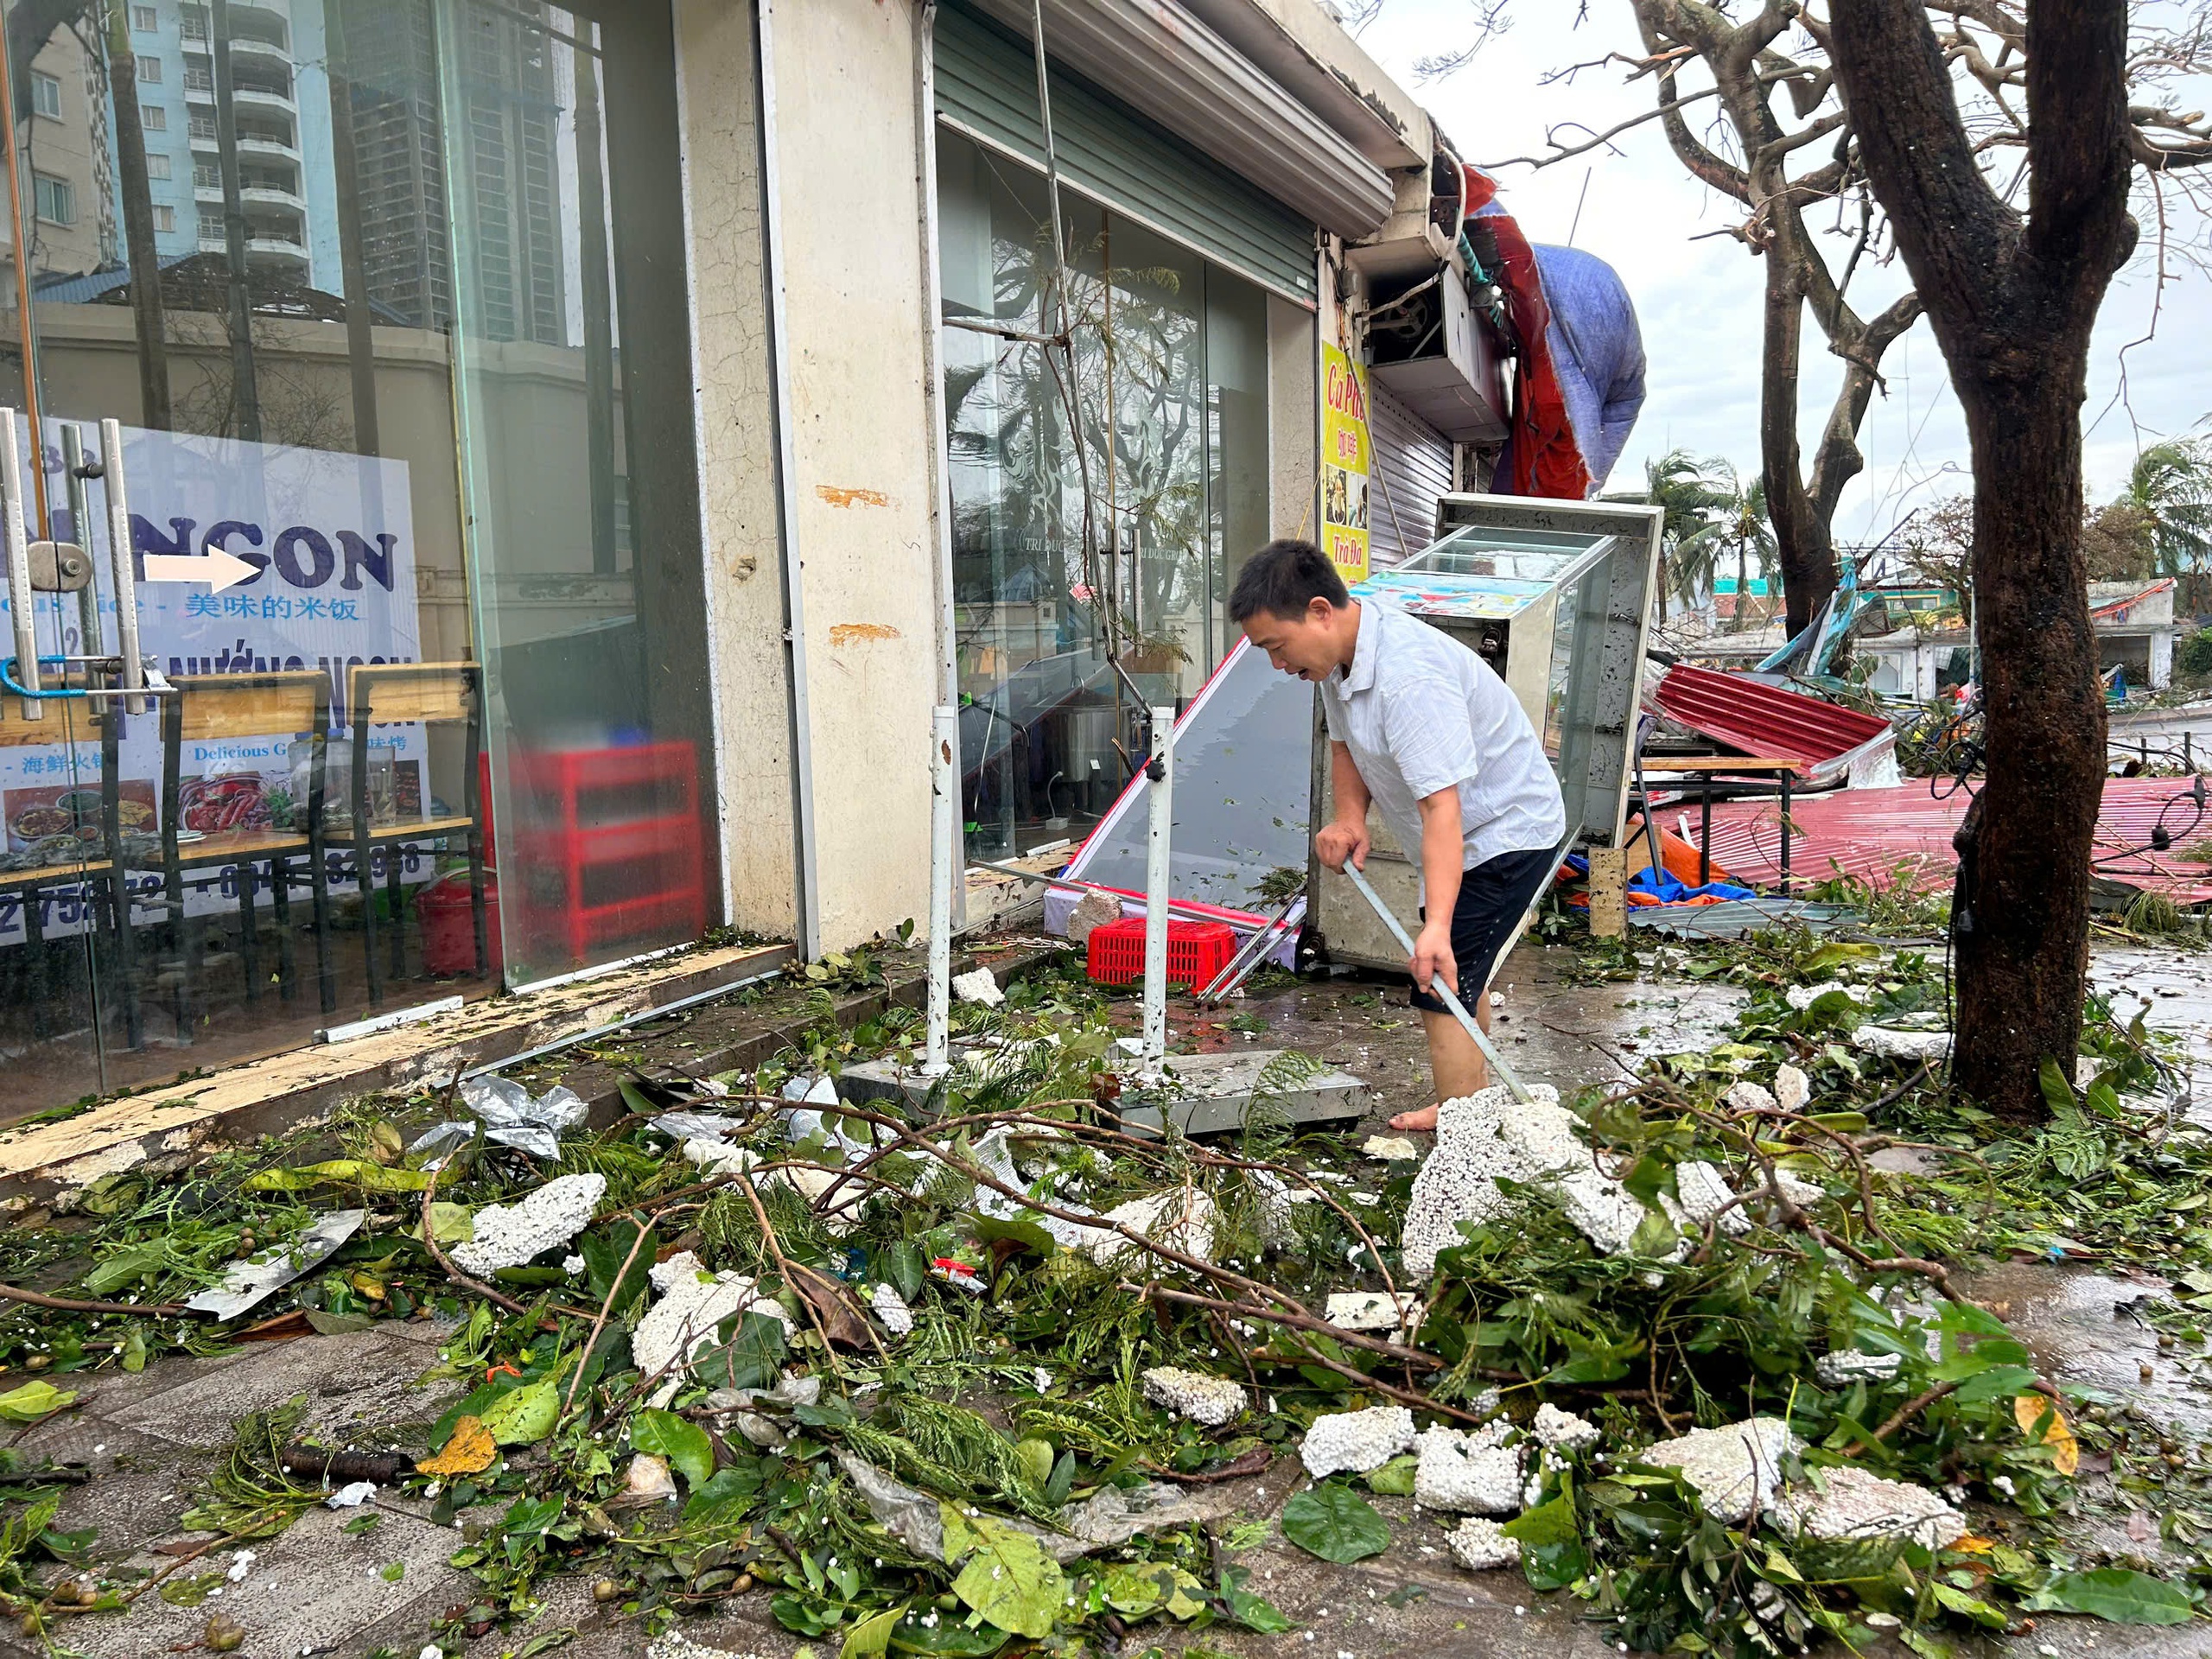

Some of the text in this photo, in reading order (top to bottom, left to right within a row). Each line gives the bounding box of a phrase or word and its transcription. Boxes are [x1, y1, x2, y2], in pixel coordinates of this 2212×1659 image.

[187, 594, 359, 621] 美味的米饭
[194, 744, 269, 760] Delicious
[371, 842, 420, 879] 98
